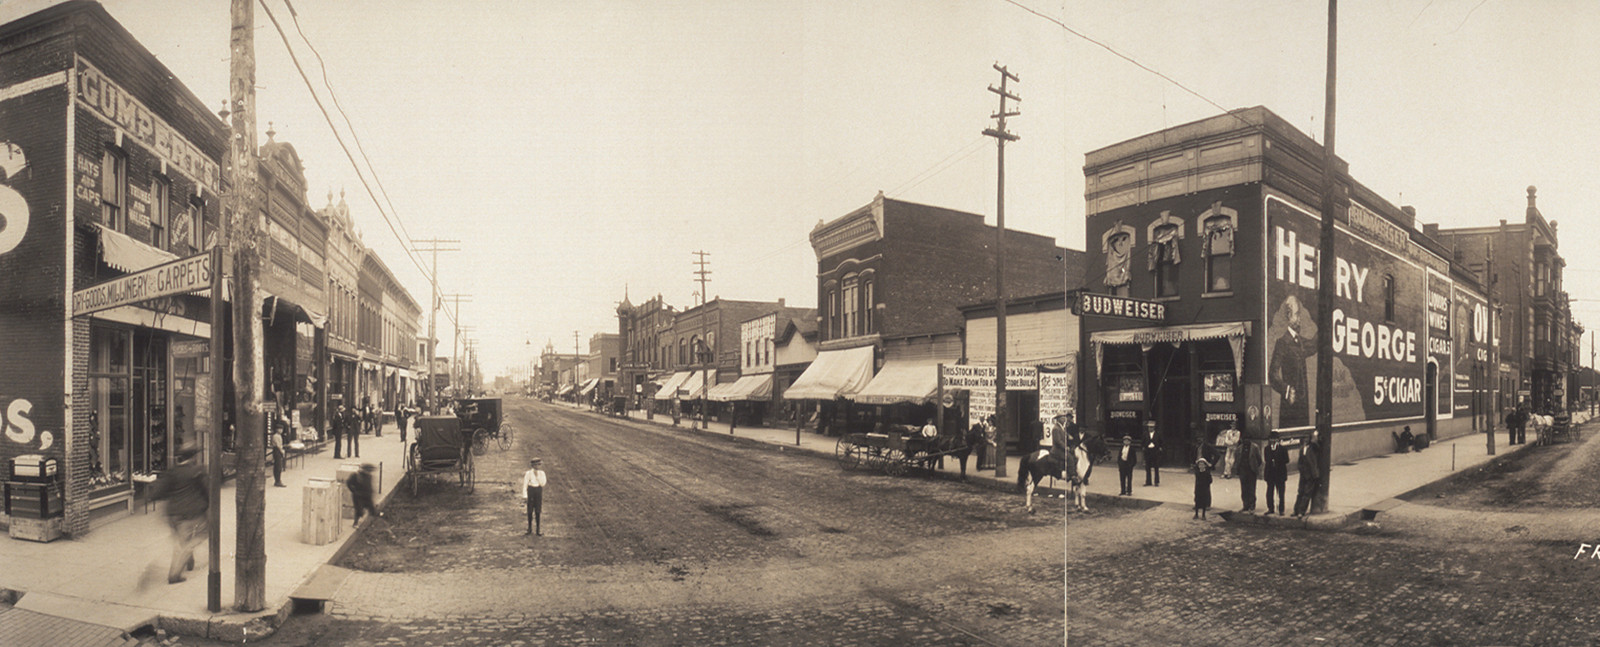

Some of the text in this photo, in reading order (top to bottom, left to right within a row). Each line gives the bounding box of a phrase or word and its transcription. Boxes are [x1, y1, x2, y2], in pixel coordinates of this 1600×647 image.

[77, 153, 100, 178] HATS
[76, 185, 100, 207] CAPS
[157, 257, 210, 293] CARPETS
[1276, 226, 1368, 302] HERY
[1083, 294, 1165, 320] BUDWEISER
[1429, 310, 1448, 331] WINES
[1332, 308, 1417, 364] GEORGE
[973, 367, 988, 377] MUST
[1388, 377, 1422, 403] CIGAR
